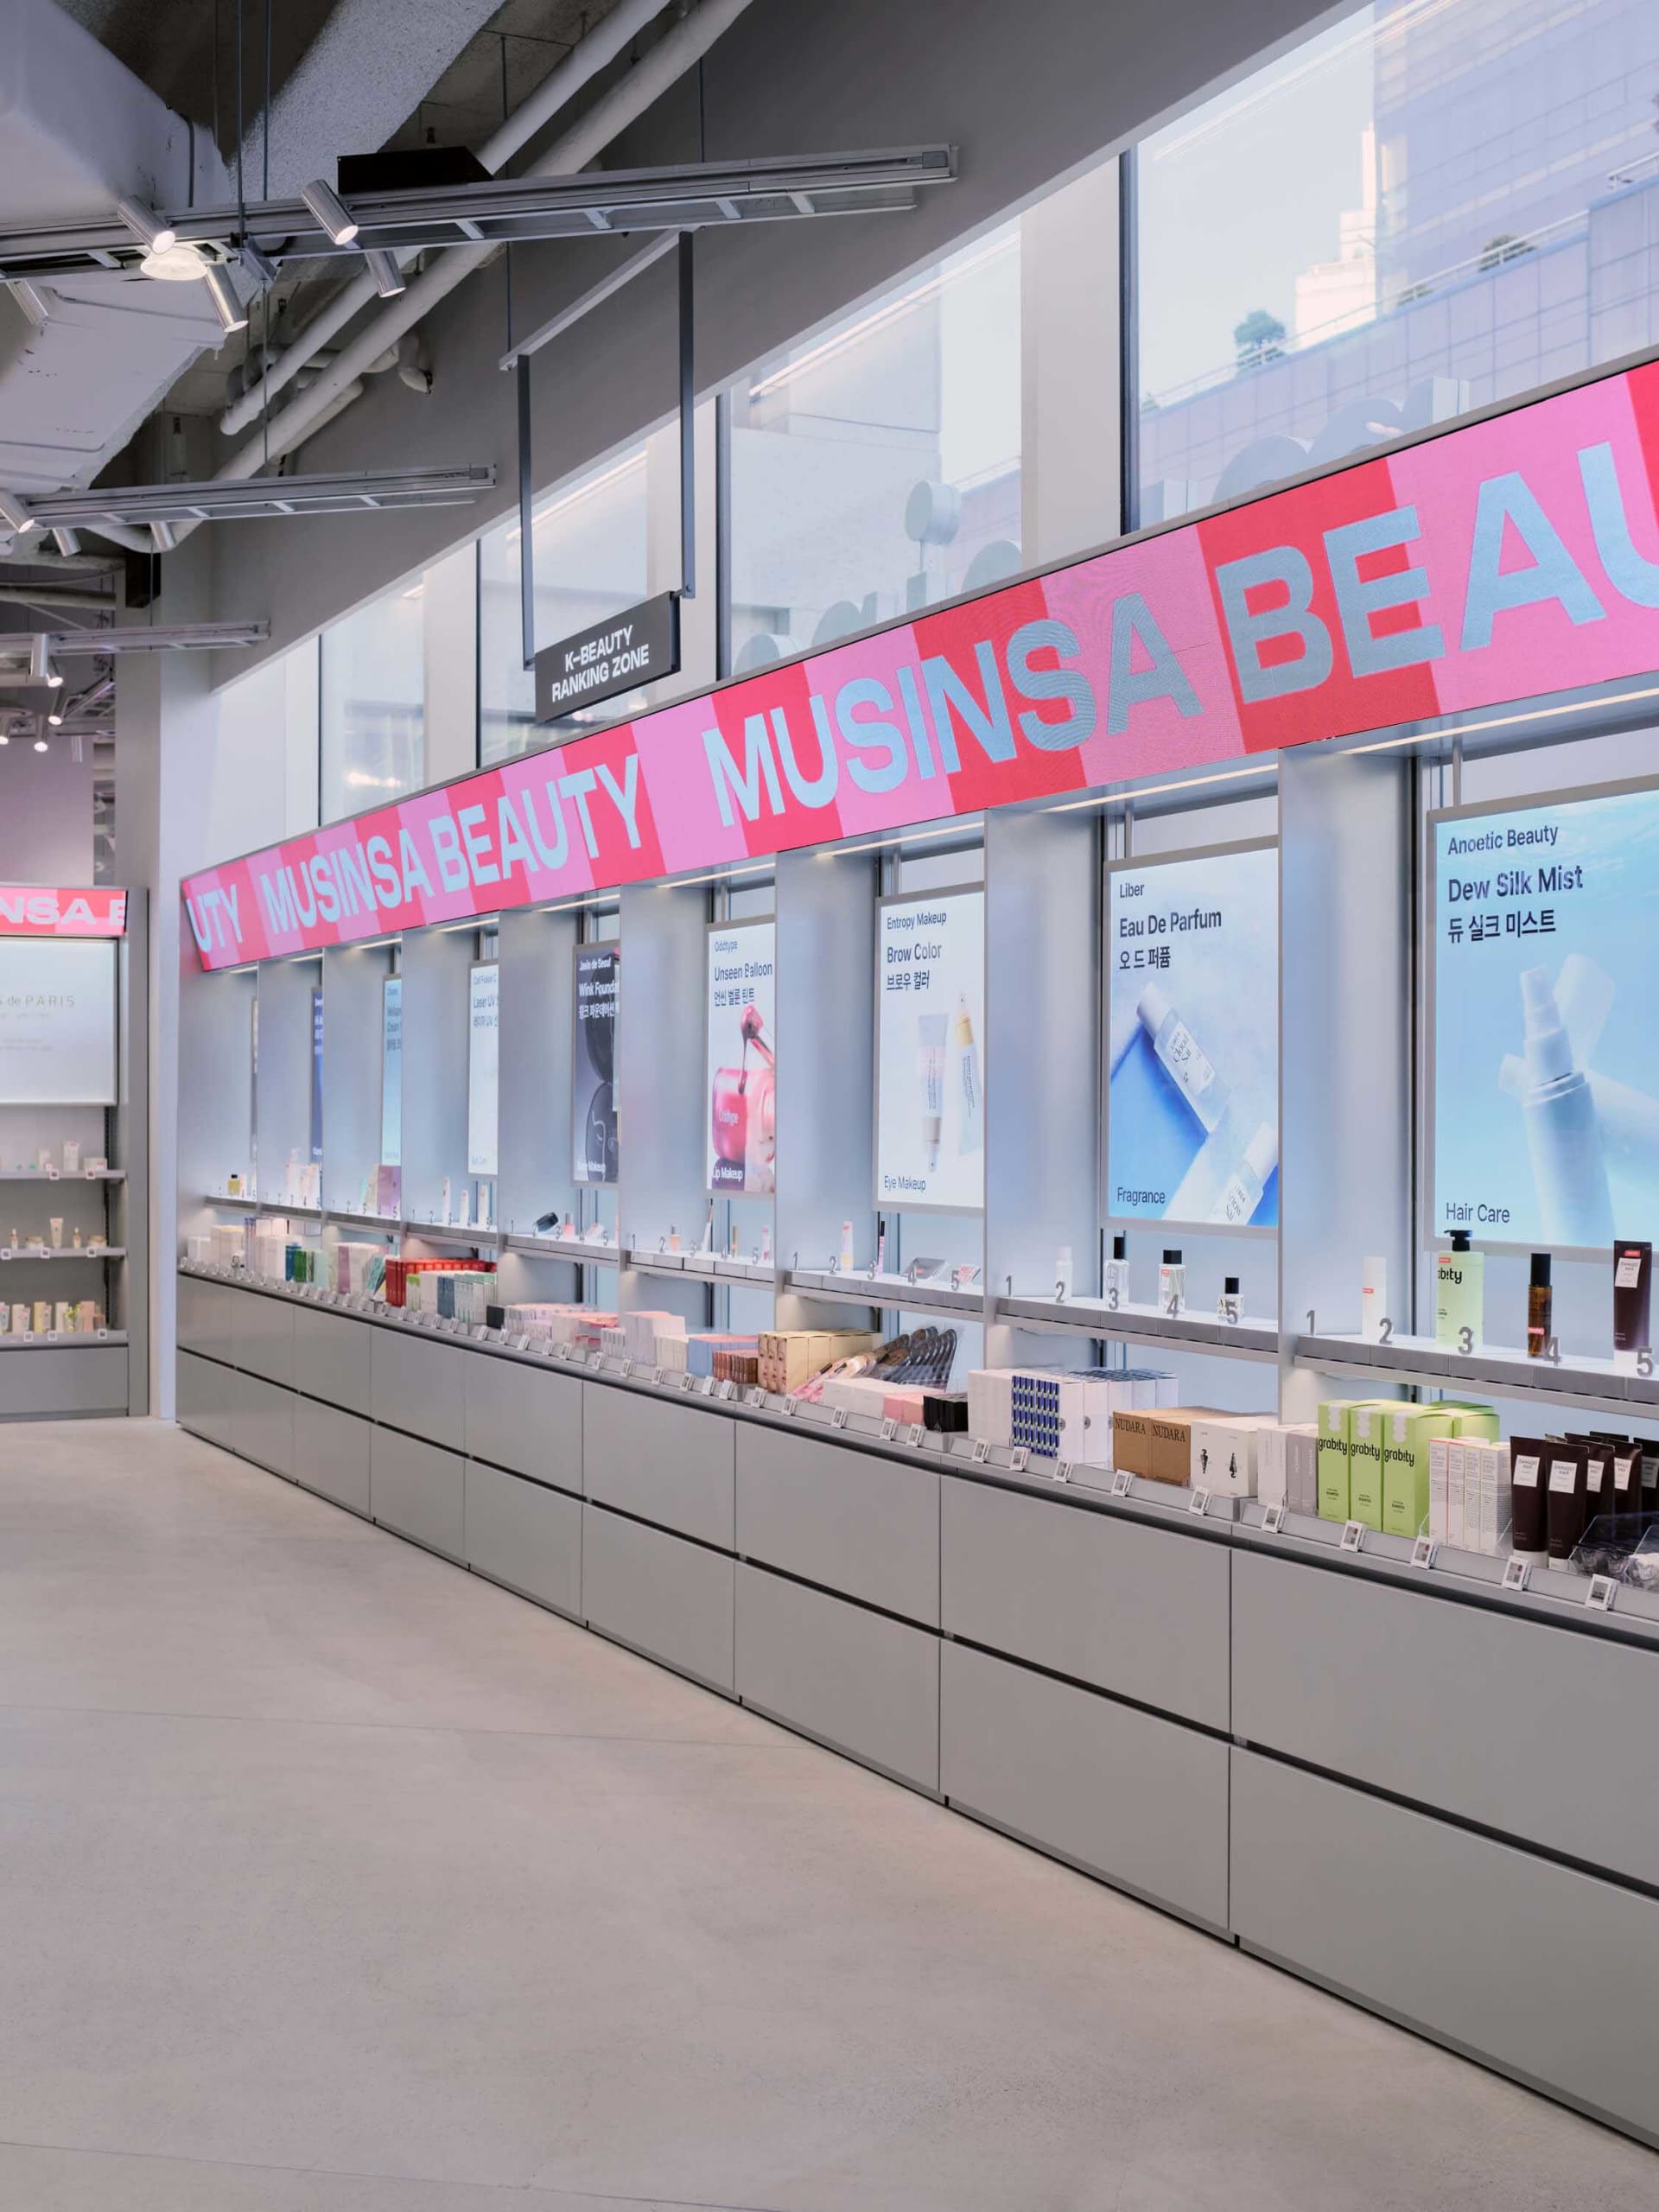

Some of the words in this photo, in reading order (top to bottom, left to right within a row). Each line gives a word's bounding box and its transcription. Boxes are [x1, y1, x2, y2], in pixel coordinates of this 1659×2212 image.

[564, 624, 633, 672] K-BEAUTY
[551, 662, 609, 702] RANKING
[612, 644, 650, 677] ZONE
[186, 884, 244, 952] UTY
[261, 829, 434, 934] MUSINSA
[429, 753, 642, 893] BEAUTY
[702, 593, 1204, 828] MUSINSA
[1447, 831, 1503, 855] Anoetic
[1507, 825, 1559, 847] Beauty
[1120, 882, 1145, 899] Liber
[1448, 878, 1491, 902] Dew
[1497, 870, 1532, 897] Silk
[1538, 864, 1583, 893] Mist
[887, 916, 915, 931] Entropy
[917, 912, 947, 926] Makeup
[1120, 918, 1144, 938] Eau
[1148, 914, 1166, 934] De
[1171, 908, 1222, 932] Parfum
[1448, 918, 1464, 944] 듀
[1469, 914, 1501, 942] 실크
[1506, 909, 1556, 938] 미스트
[715, 940, 738, 954] Oddtype
[887, 946, 912, 963] Brow
[914, 941, 942, 961] Color
[1148, 946, 1171, 969] 퍼퓸
[715, 966, 743, 982] Unseen
[745, 962, 772, 978] Balloon
[887, 973, 911, 991] 브로우
[913, 969, 930, 990] 컬러
[579, 982, 594, 996] Wink
[25, 995, 75, 1007] PARIS
[721, 1166, 744, 1182] Makeup
[884, 1175, 897, 1191] Eye
[898, 1176, 926, 1193] Makeup
[1117, 1186, 1166, 1206] Fragrance
[1446, 1202, 1473, 1221] Hair
[1478, 1204, 1510, 1224] Care
[659, 1236, 665, 1253] 2
[752, 1246, 760, 1264] 5
[793, 1251, 798, 1270] 1
[830, 1255, 837, 1274] 2
[868, 1260, 876, 1281] 3
[908, 1262, 918, 1286] 4
[950, 1270, 959, 1291] 5
[1006, 1275, 1013, 1296] 1
[1055, 1281, 1065, 1303] 2
[1108, 1287, 1119, 1310] 3
[1166, 1294, 1179, 1319] 4
[1225, 1300, 1238, 1324] 5
[1306, 1309, 1315, 1336] 1
[1378, 1318, 1393, 1345] 2
[1458, 1326, 1474, 1356] 3
[1541, 1337, 1560, 1366] 4
[1636, 1345, 1654, 1378] 5
[1115, 1418, 1147, 1435] NUDARA
[1152, 1425, 1186, 1443] NUDARA
